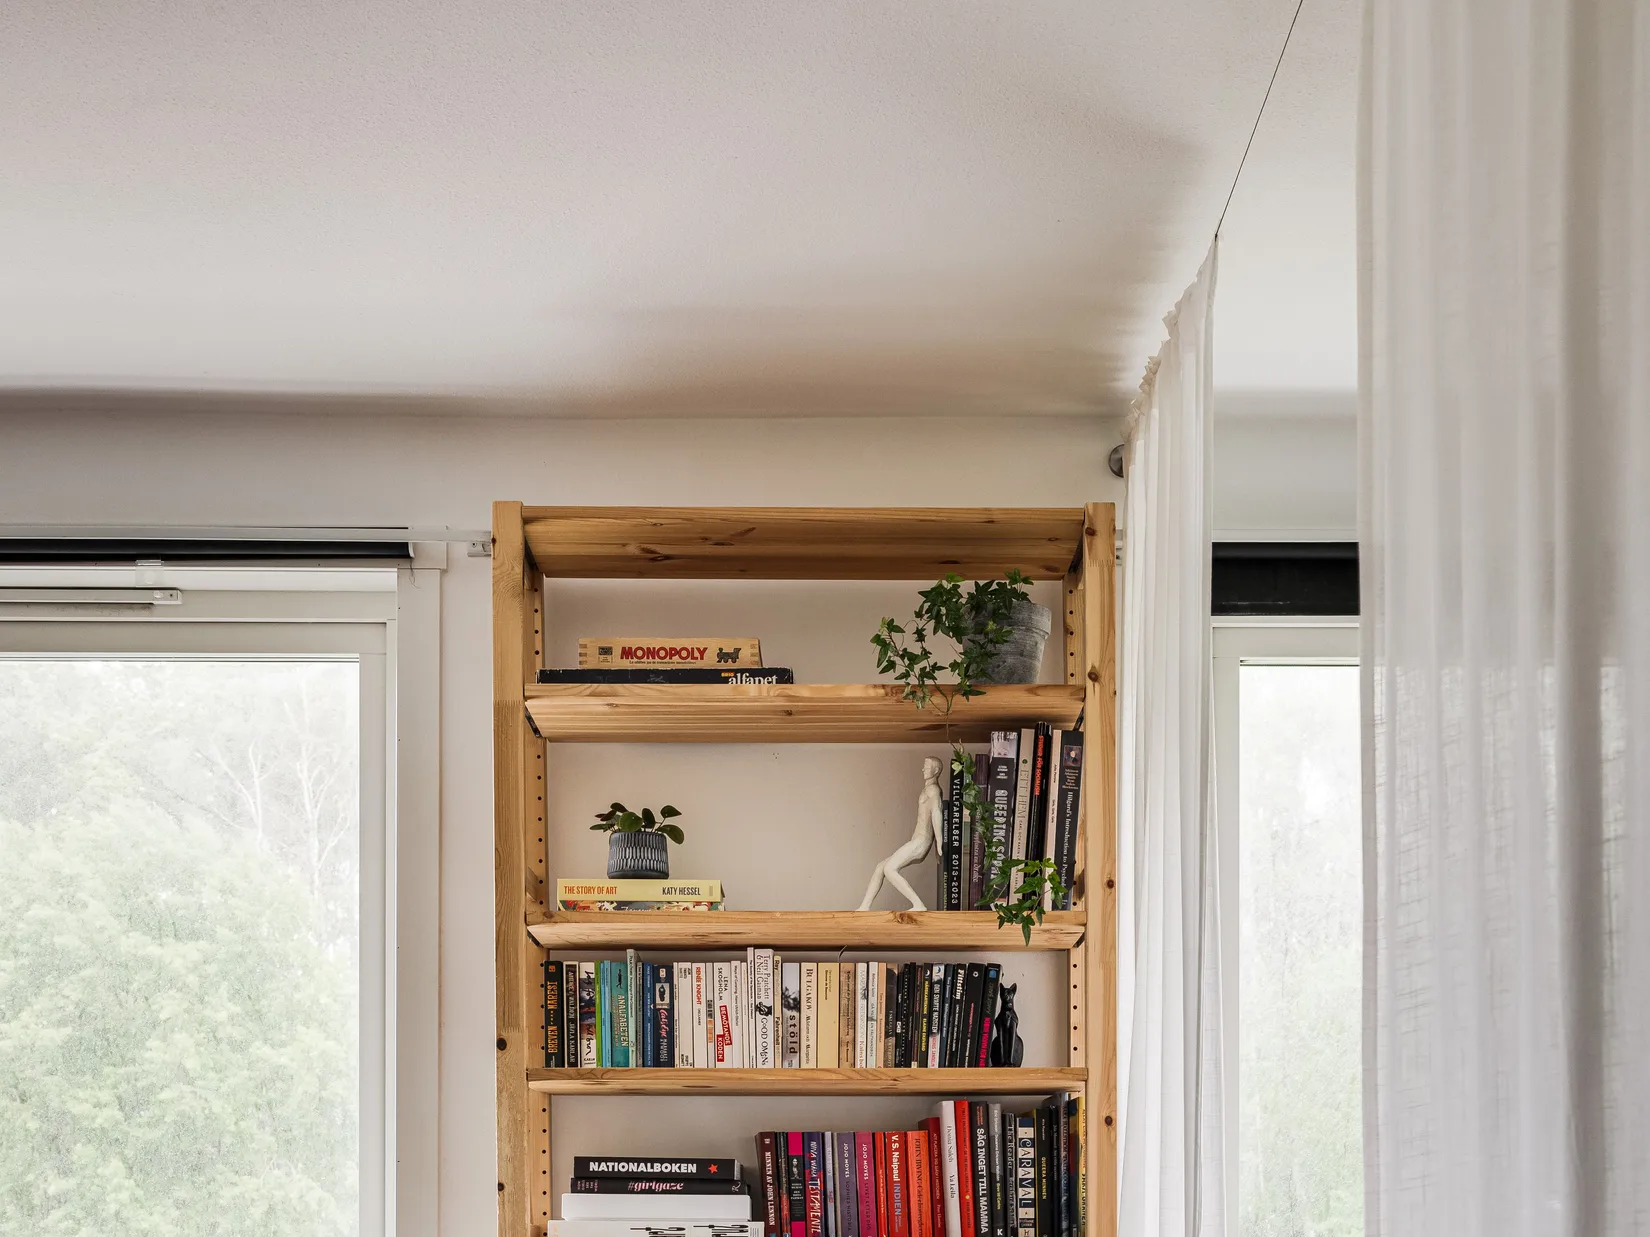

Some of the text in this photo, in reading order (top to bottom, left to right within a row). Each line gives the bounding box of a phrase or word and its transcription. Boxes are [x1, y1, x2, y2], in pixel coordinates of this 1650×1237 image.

[620, 646, 708, 660] MONOPOLY
[1019, 769, 1030, 791] ETT
[952, 779, 960, 847] VILLFARELSER
[1016, 794, 1028, 819] HEM
[1063, 818, 1071, 854] Introduction
[973, 864, 982, 883] drake
[564, 886, 575, 894] THE
[576, 886, 596, 894] STORY
[662, 887, 701, 895] KATY HESSEL
[805, 968, 813, 1011] BULGAKOV
[955, 969, 964, 1000] Fittstim
[617, 994, 628, 1047] ANALFABETEN
[721, 1007, 731, 1044] BEMÖTANDE
[789, 1015, 798, 1054] stöld
[548, 1025, 558, 1053] BREVEN
[977, 1128, 987, 1147] SÄG
[589, 1162, 697, 1173] NATIONALBOKEN
[891, 1152, 900, 1181] Naipaul
[978, 1148, 986, 1176] INGET
[1020, 1138, 1032, 1207] CARAVAL
[628, 1180, 684, 1192] #girlgaze
[949, 1174, 955, 1182] Ya
[808, 1179, 821, 1234] TESTAMENTE
[980, 1197, 988, 1233] MAMMA
